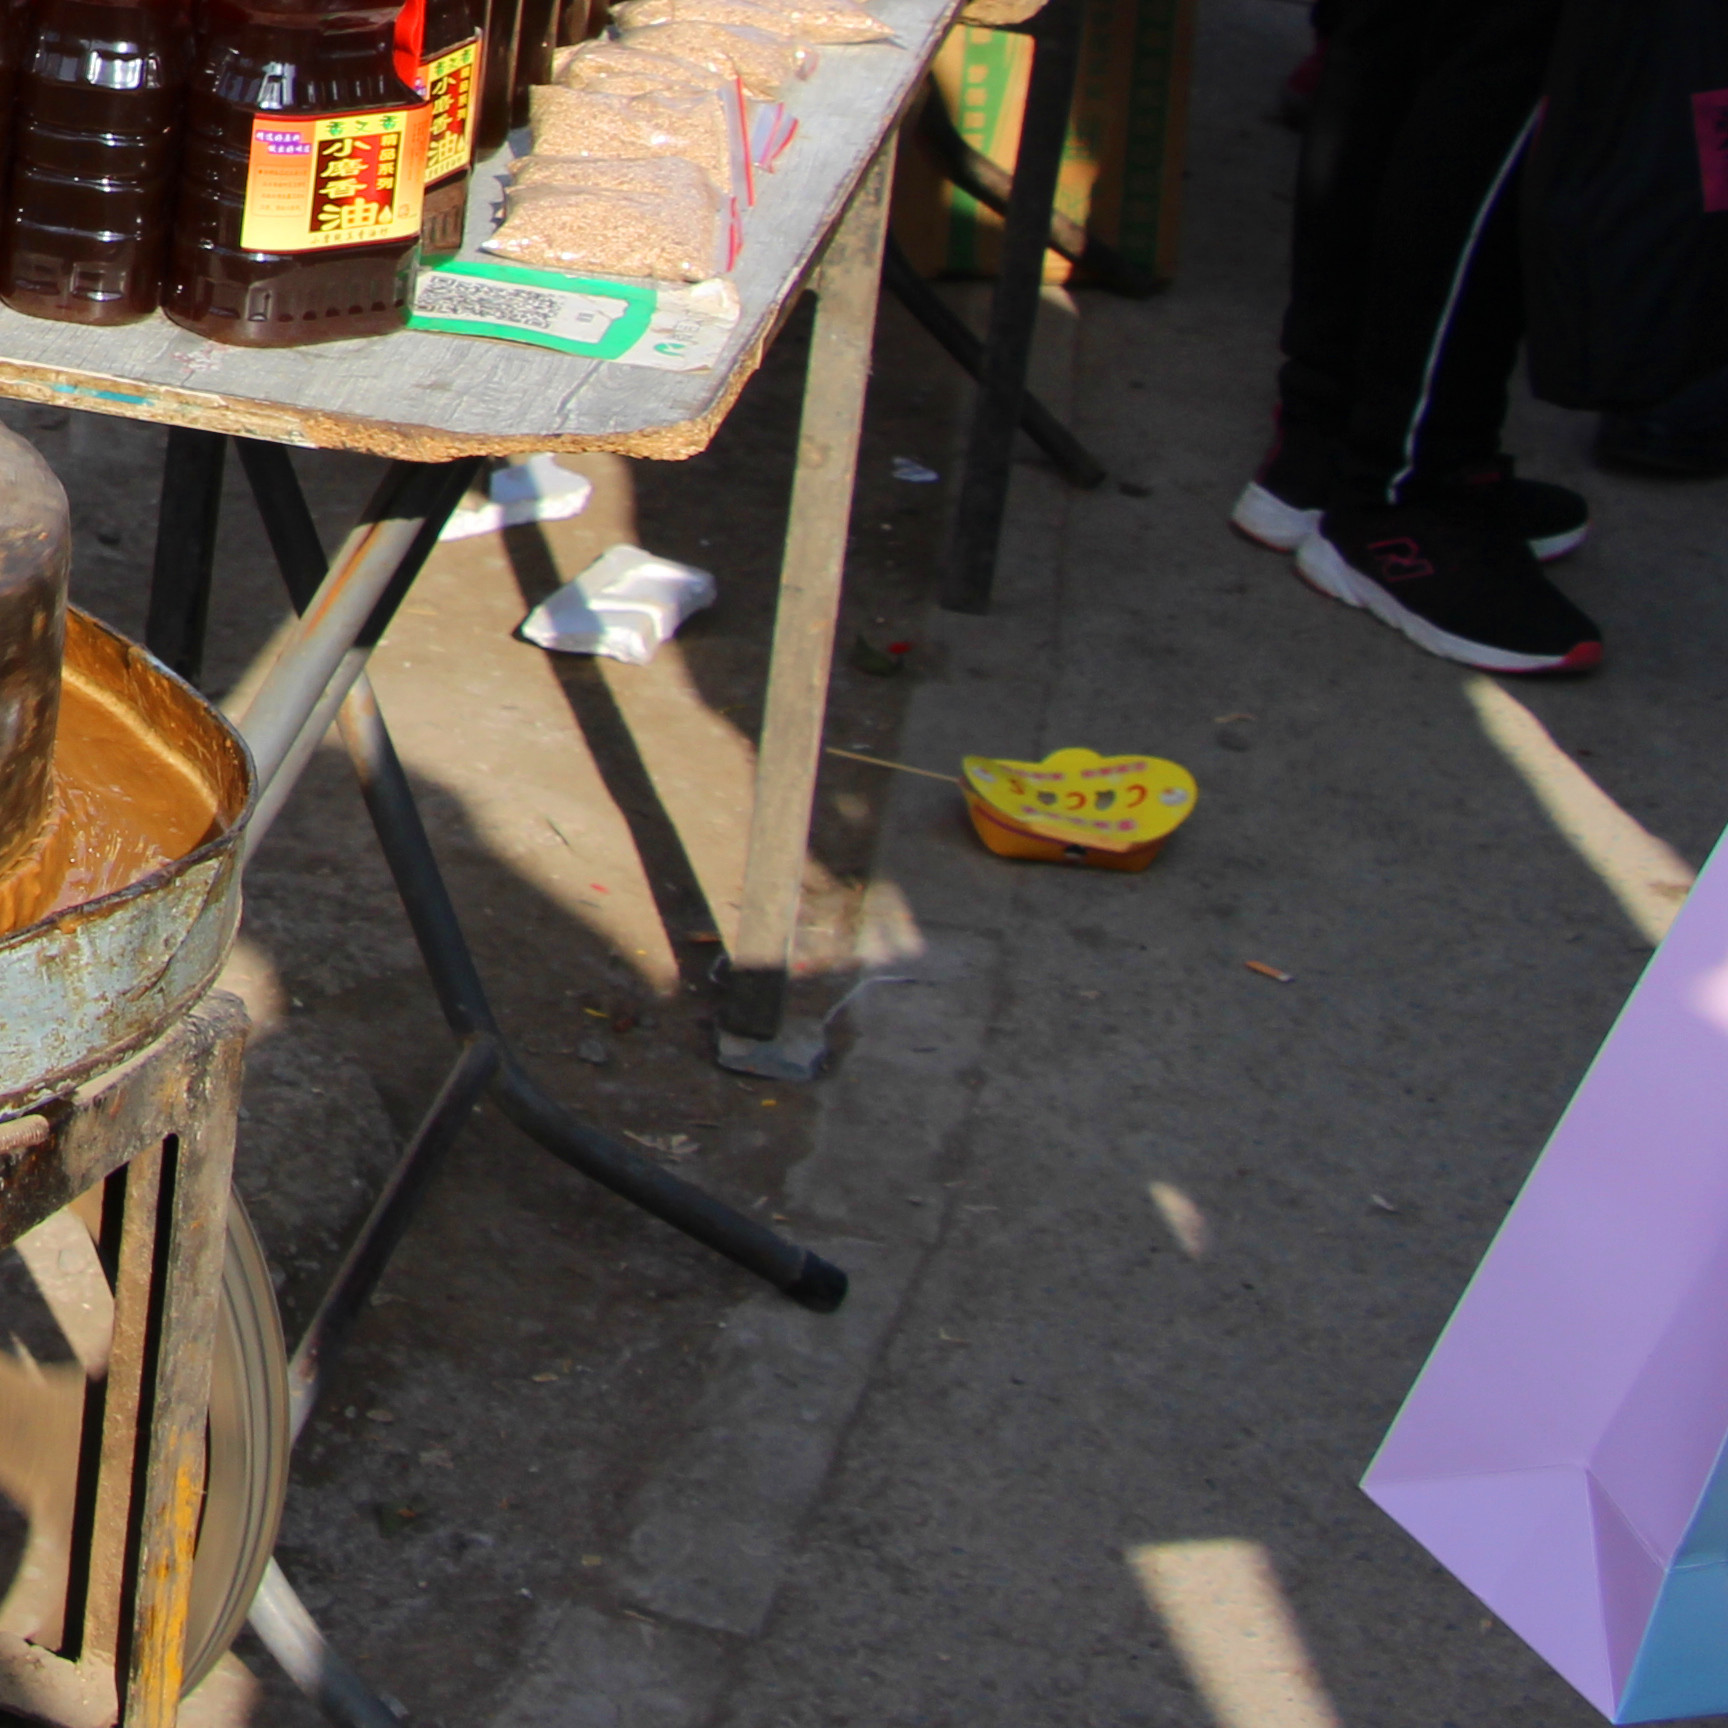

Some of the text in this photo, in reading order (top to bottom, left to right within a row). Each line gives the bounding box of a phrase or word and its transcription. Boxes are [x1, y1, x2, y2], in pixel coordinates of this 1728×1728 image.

[317, 138, 380, 232] 小磨香油
[375, 133, 398, 191] 精品系列
